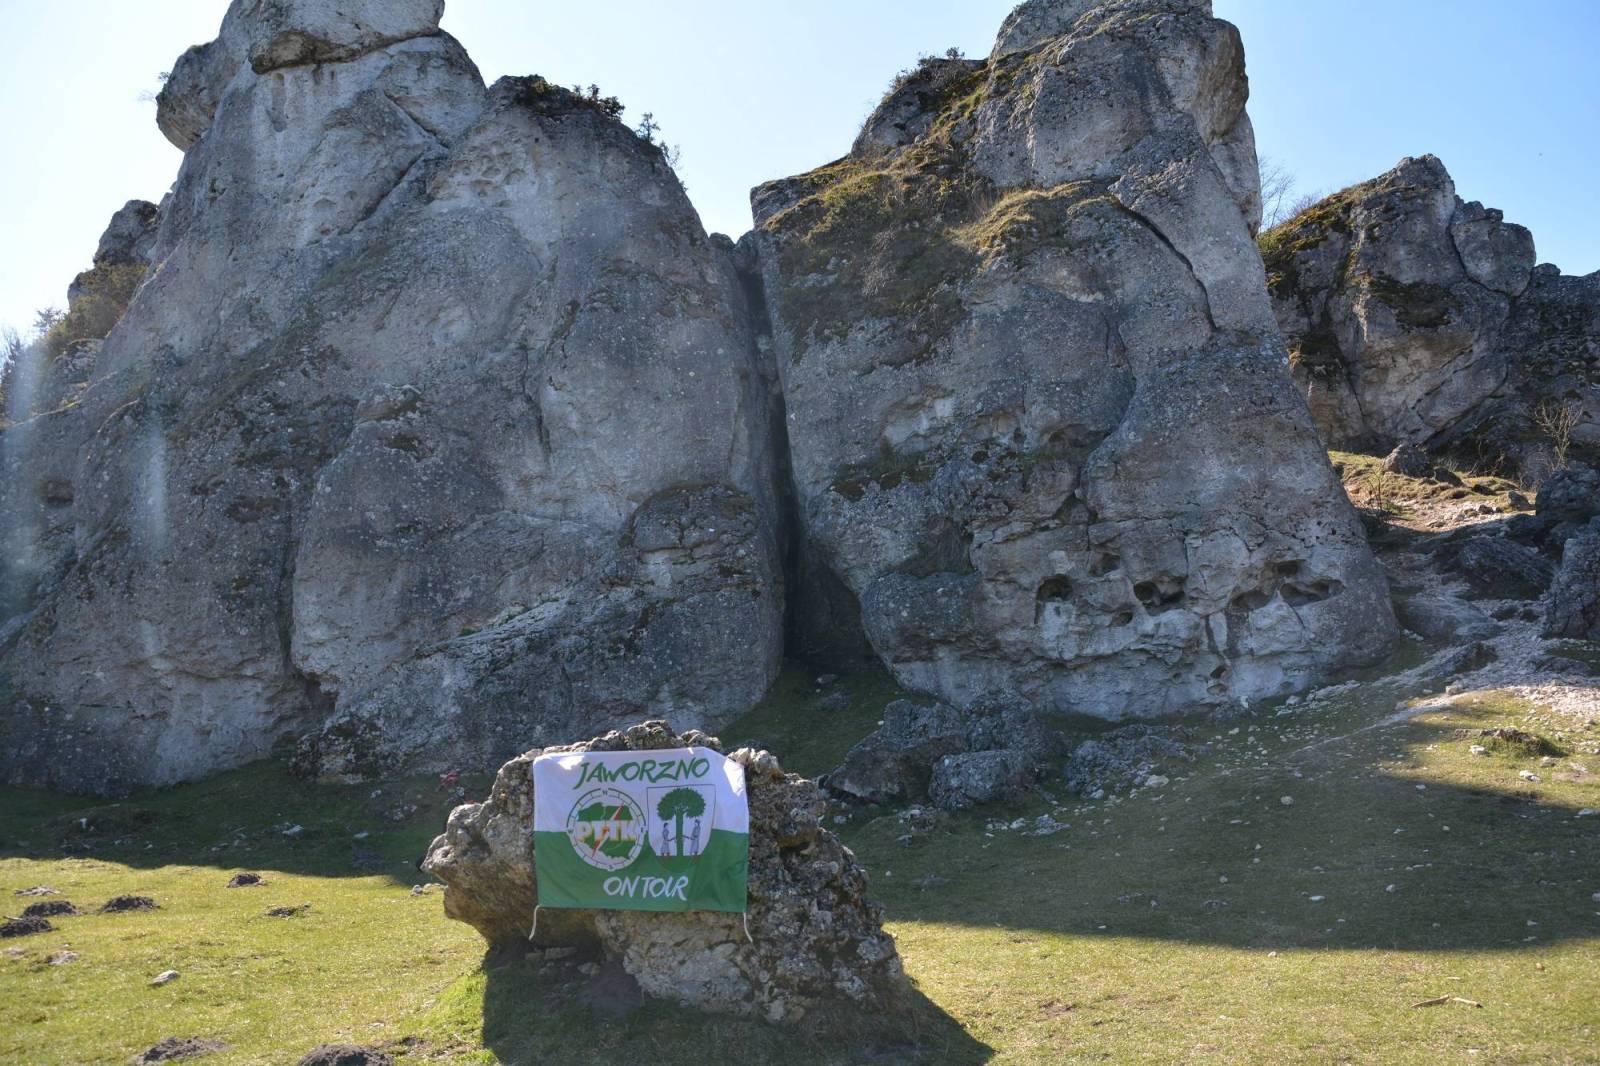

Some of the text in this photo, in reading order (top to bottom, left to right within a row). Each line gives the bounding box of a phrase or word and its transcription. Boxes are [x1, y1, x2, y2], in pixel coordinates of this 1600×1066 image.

[573, 757, 710, 789] JAWORZNO
[576, 820, 637, 842] PTTK
[603, 876, 689, 900] ON TOUR
